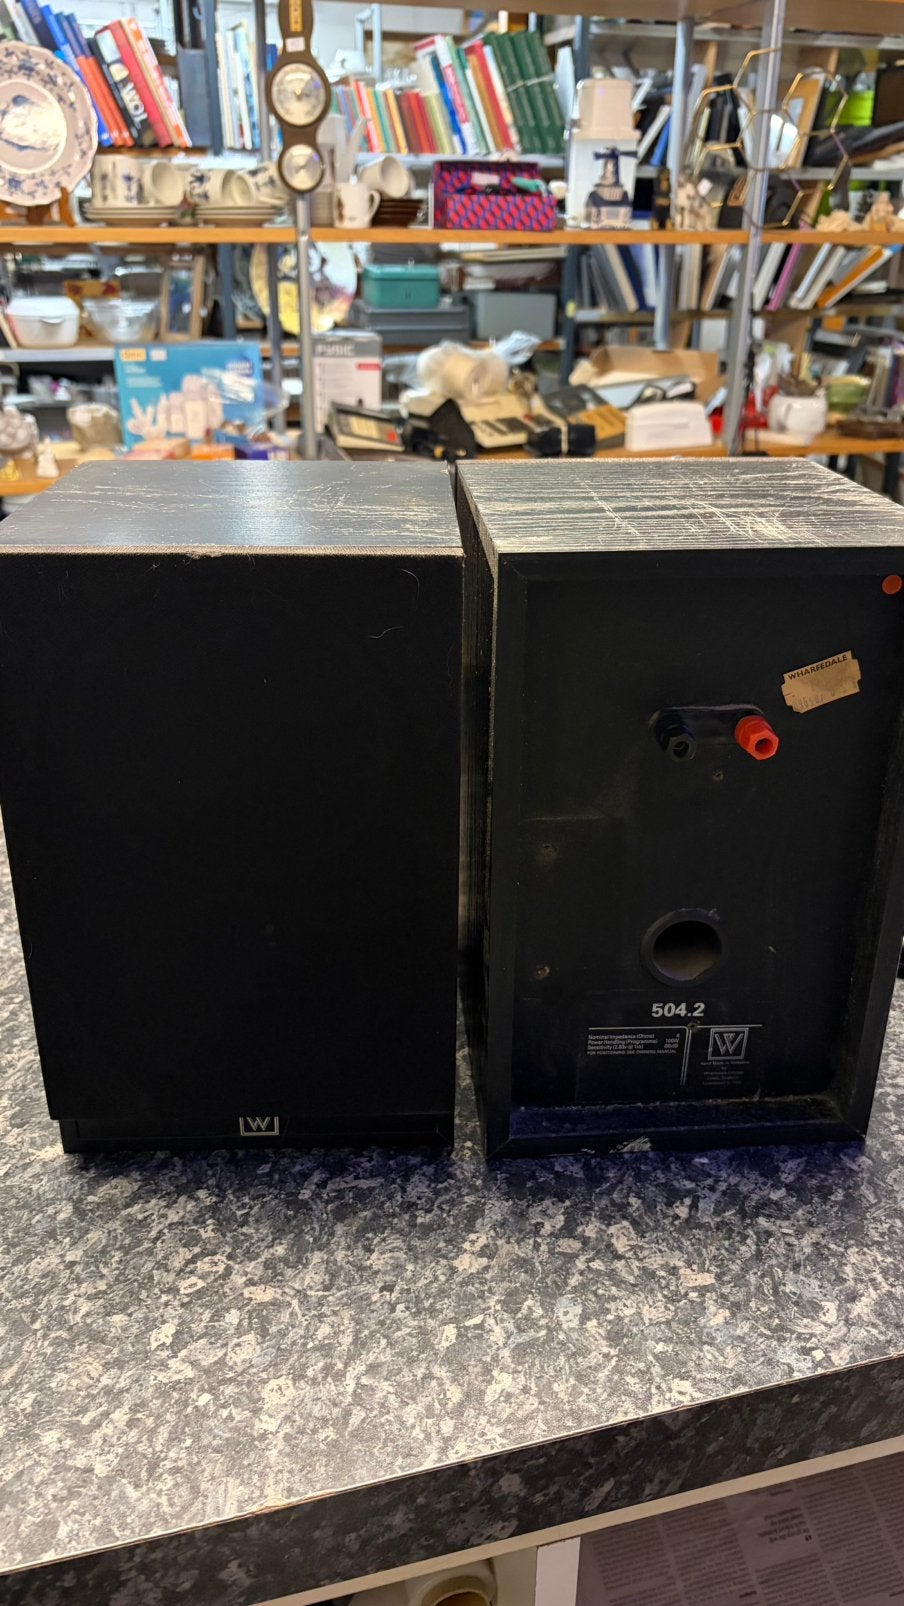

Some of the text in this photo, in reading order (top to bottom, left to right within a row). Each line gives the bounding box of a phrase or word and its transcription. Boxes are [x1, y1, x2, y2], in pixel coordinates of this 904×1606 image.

[787, 654, 848, 680] WHARFEDALE
[651, 1002, 706, 1017] 504.2
[246, 1116, 272, 1131] W
